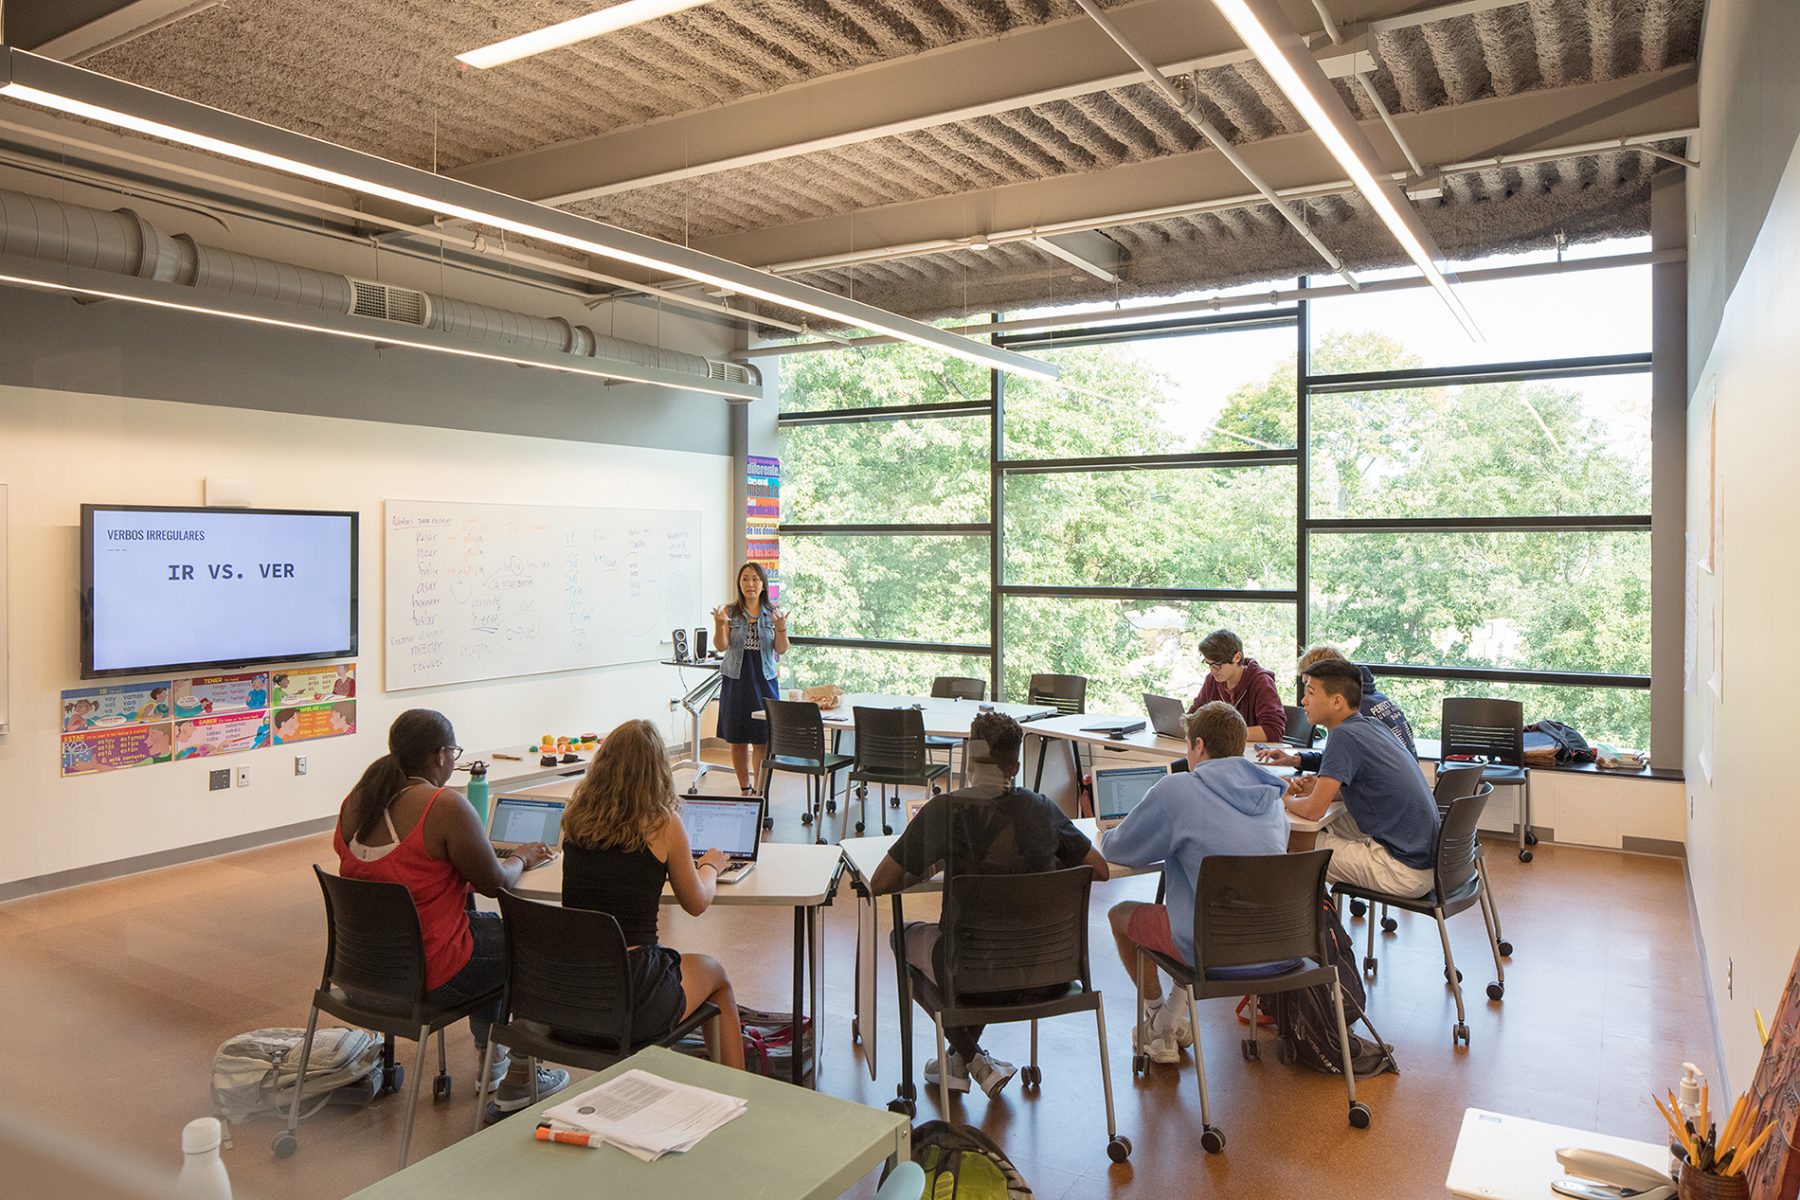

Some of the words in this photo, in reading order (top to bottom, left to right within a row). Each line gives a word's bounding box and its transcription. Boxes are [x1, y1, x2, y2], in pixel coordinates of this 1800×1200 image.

[107, 529, 144, 541] VERBOS
[147, 530, 205, 541] IRREGULARES
[168, 564, 194, 581] IR
[208, 564, 243, 580] VS.
[259, 563, 295, 578] VER
